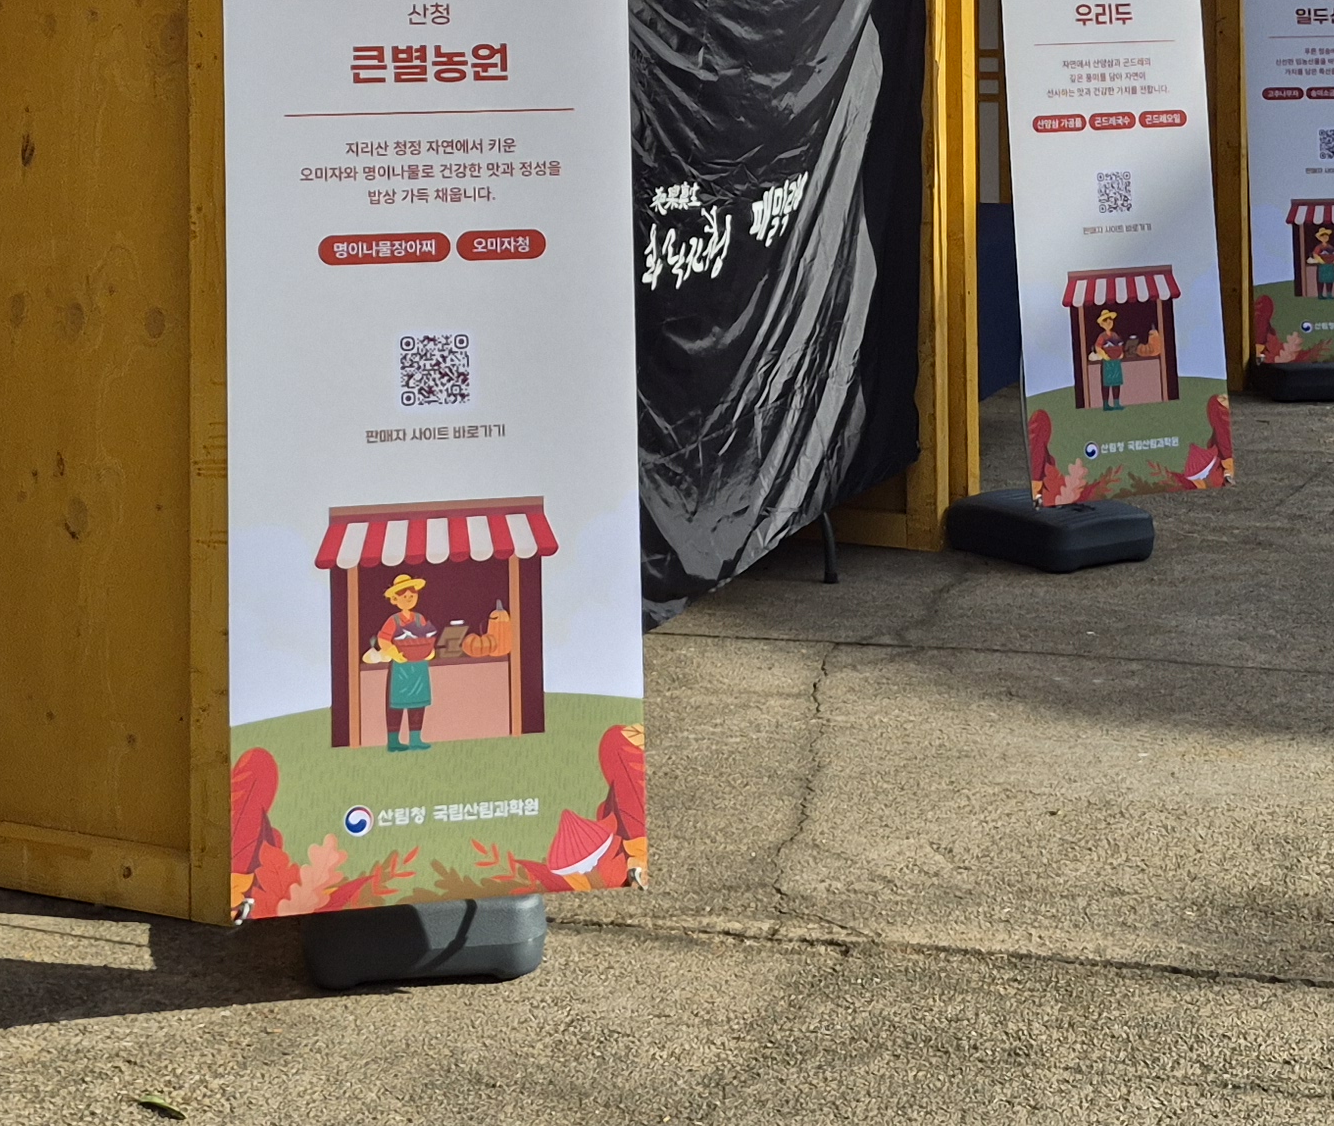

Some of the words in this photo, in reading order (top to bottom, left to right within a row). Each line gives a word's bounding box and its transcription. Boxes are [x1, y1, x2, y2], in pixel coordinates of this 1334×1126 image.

[407, 3, 451, 26] 산청
[1075, 3, 1133, 26] 우리두
[350, 43, 509, 84] 큰별농원
[346, 140, 389, 157] 지리산
[393, 139, 422, 157] 청정
[426, 138, 484, 156] 자연에서
[488, 137, 517, 154] 키운
[300, 165, 358, 182] 오미자와
[362, 164, 435, 181] 명이나물로
[439, 162, 482, 179] 건강한
[486, 161, 515, 178] 맛과
[519, 160, 562, 177] 정성을
[368, 188, 397, 205] 밥상
[401, 187, 430, 204] 가득
[434, 186, 496, 203] 채웁니다.
[333, 239, 436, 259] 명이나물장아찌
[472, 236, 530, 254] 오미자청
[366, 429, 407, 444] 판매자
[410, 426, 450, 442] 사이트
[453, 424, 506, 440] 바로가기
[377, 806, 426, 827] 산림청
[433, 798, 539, 822] 국립산림과학원
